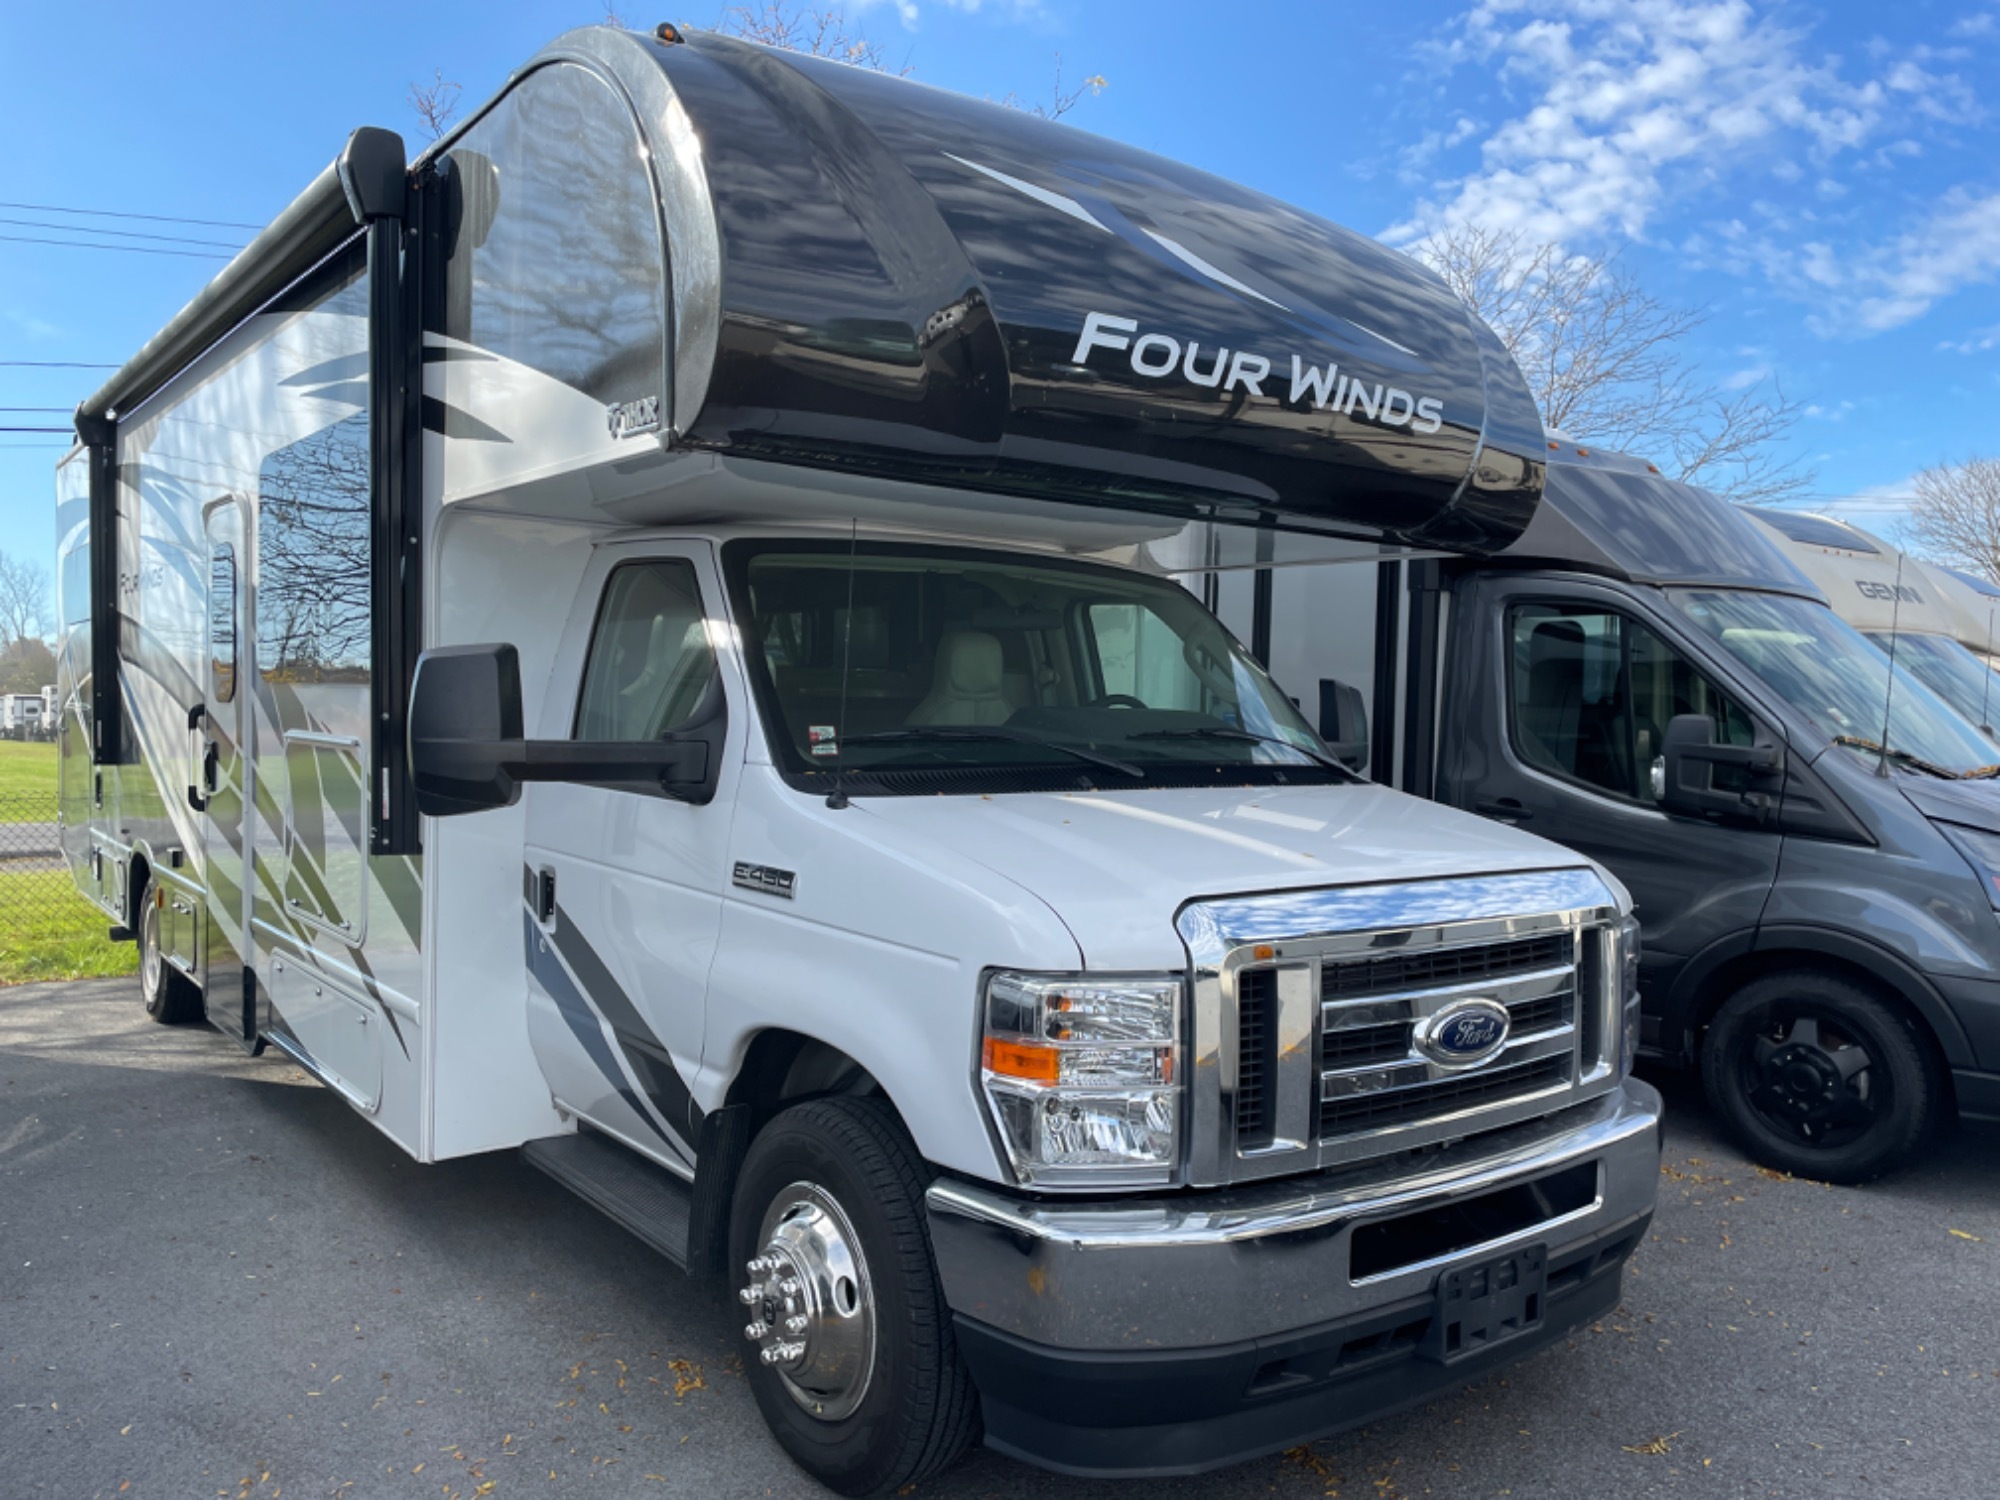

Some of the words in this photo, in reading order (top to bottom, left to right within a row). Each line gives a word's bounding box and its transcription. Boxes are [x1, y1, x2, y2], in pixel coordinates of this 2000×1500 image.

[1071, 310, 1271, 397] FOUR
[1290, 354, 1444, 435] WINDS
[620, 396, 659, 431] THOR
[1454, 1017, 1496, 1047] Ford
